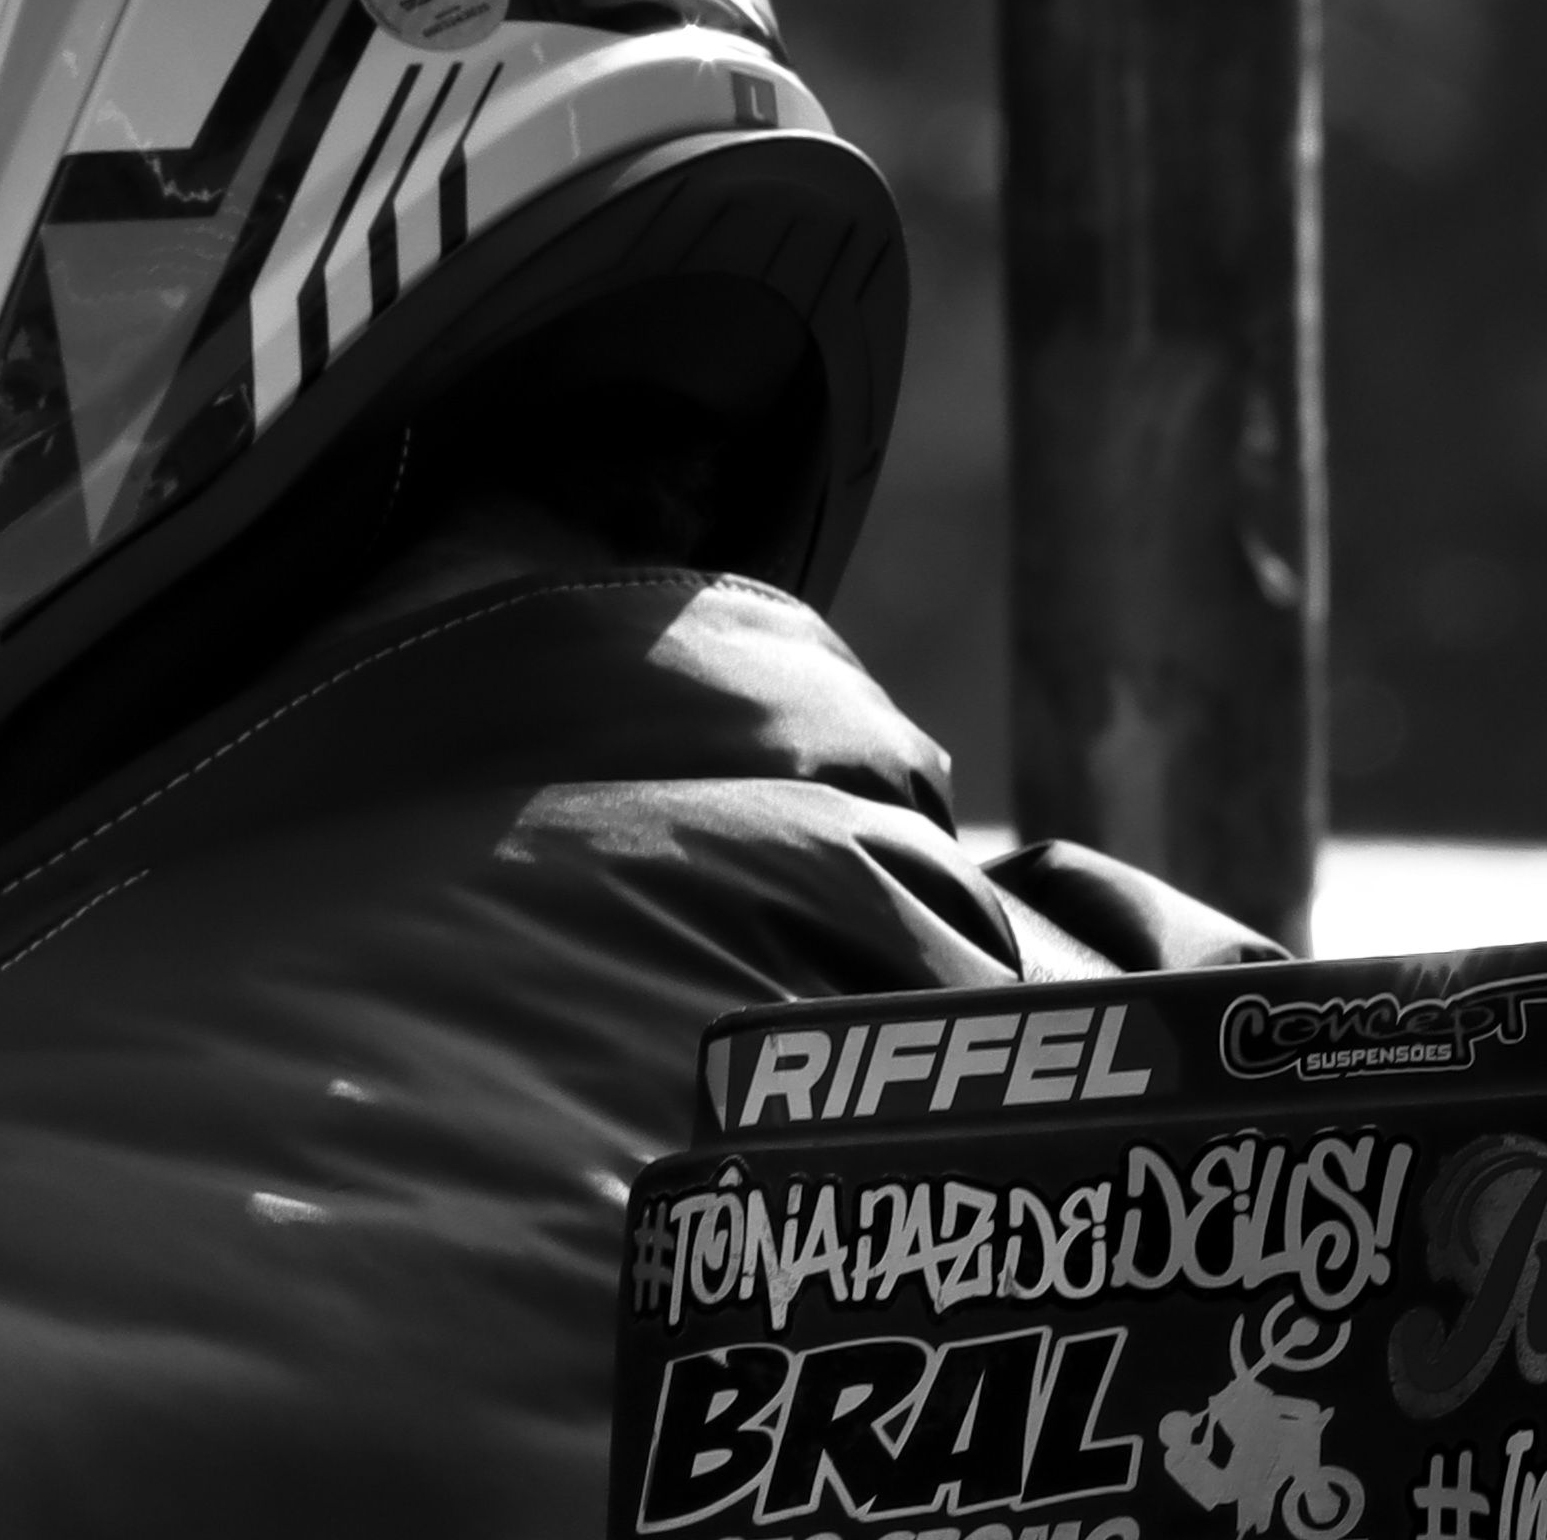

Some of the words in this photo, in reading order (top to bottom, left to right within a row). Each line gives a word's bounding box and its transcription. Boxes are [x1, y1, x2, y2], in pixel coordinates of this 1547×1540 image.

[739, 1003, 1155, 1127] RIFFEL
[1306, 1042, 1453, 1073] SUSPENSÕES
[635, 1326, 1145, 1535] BRAL
